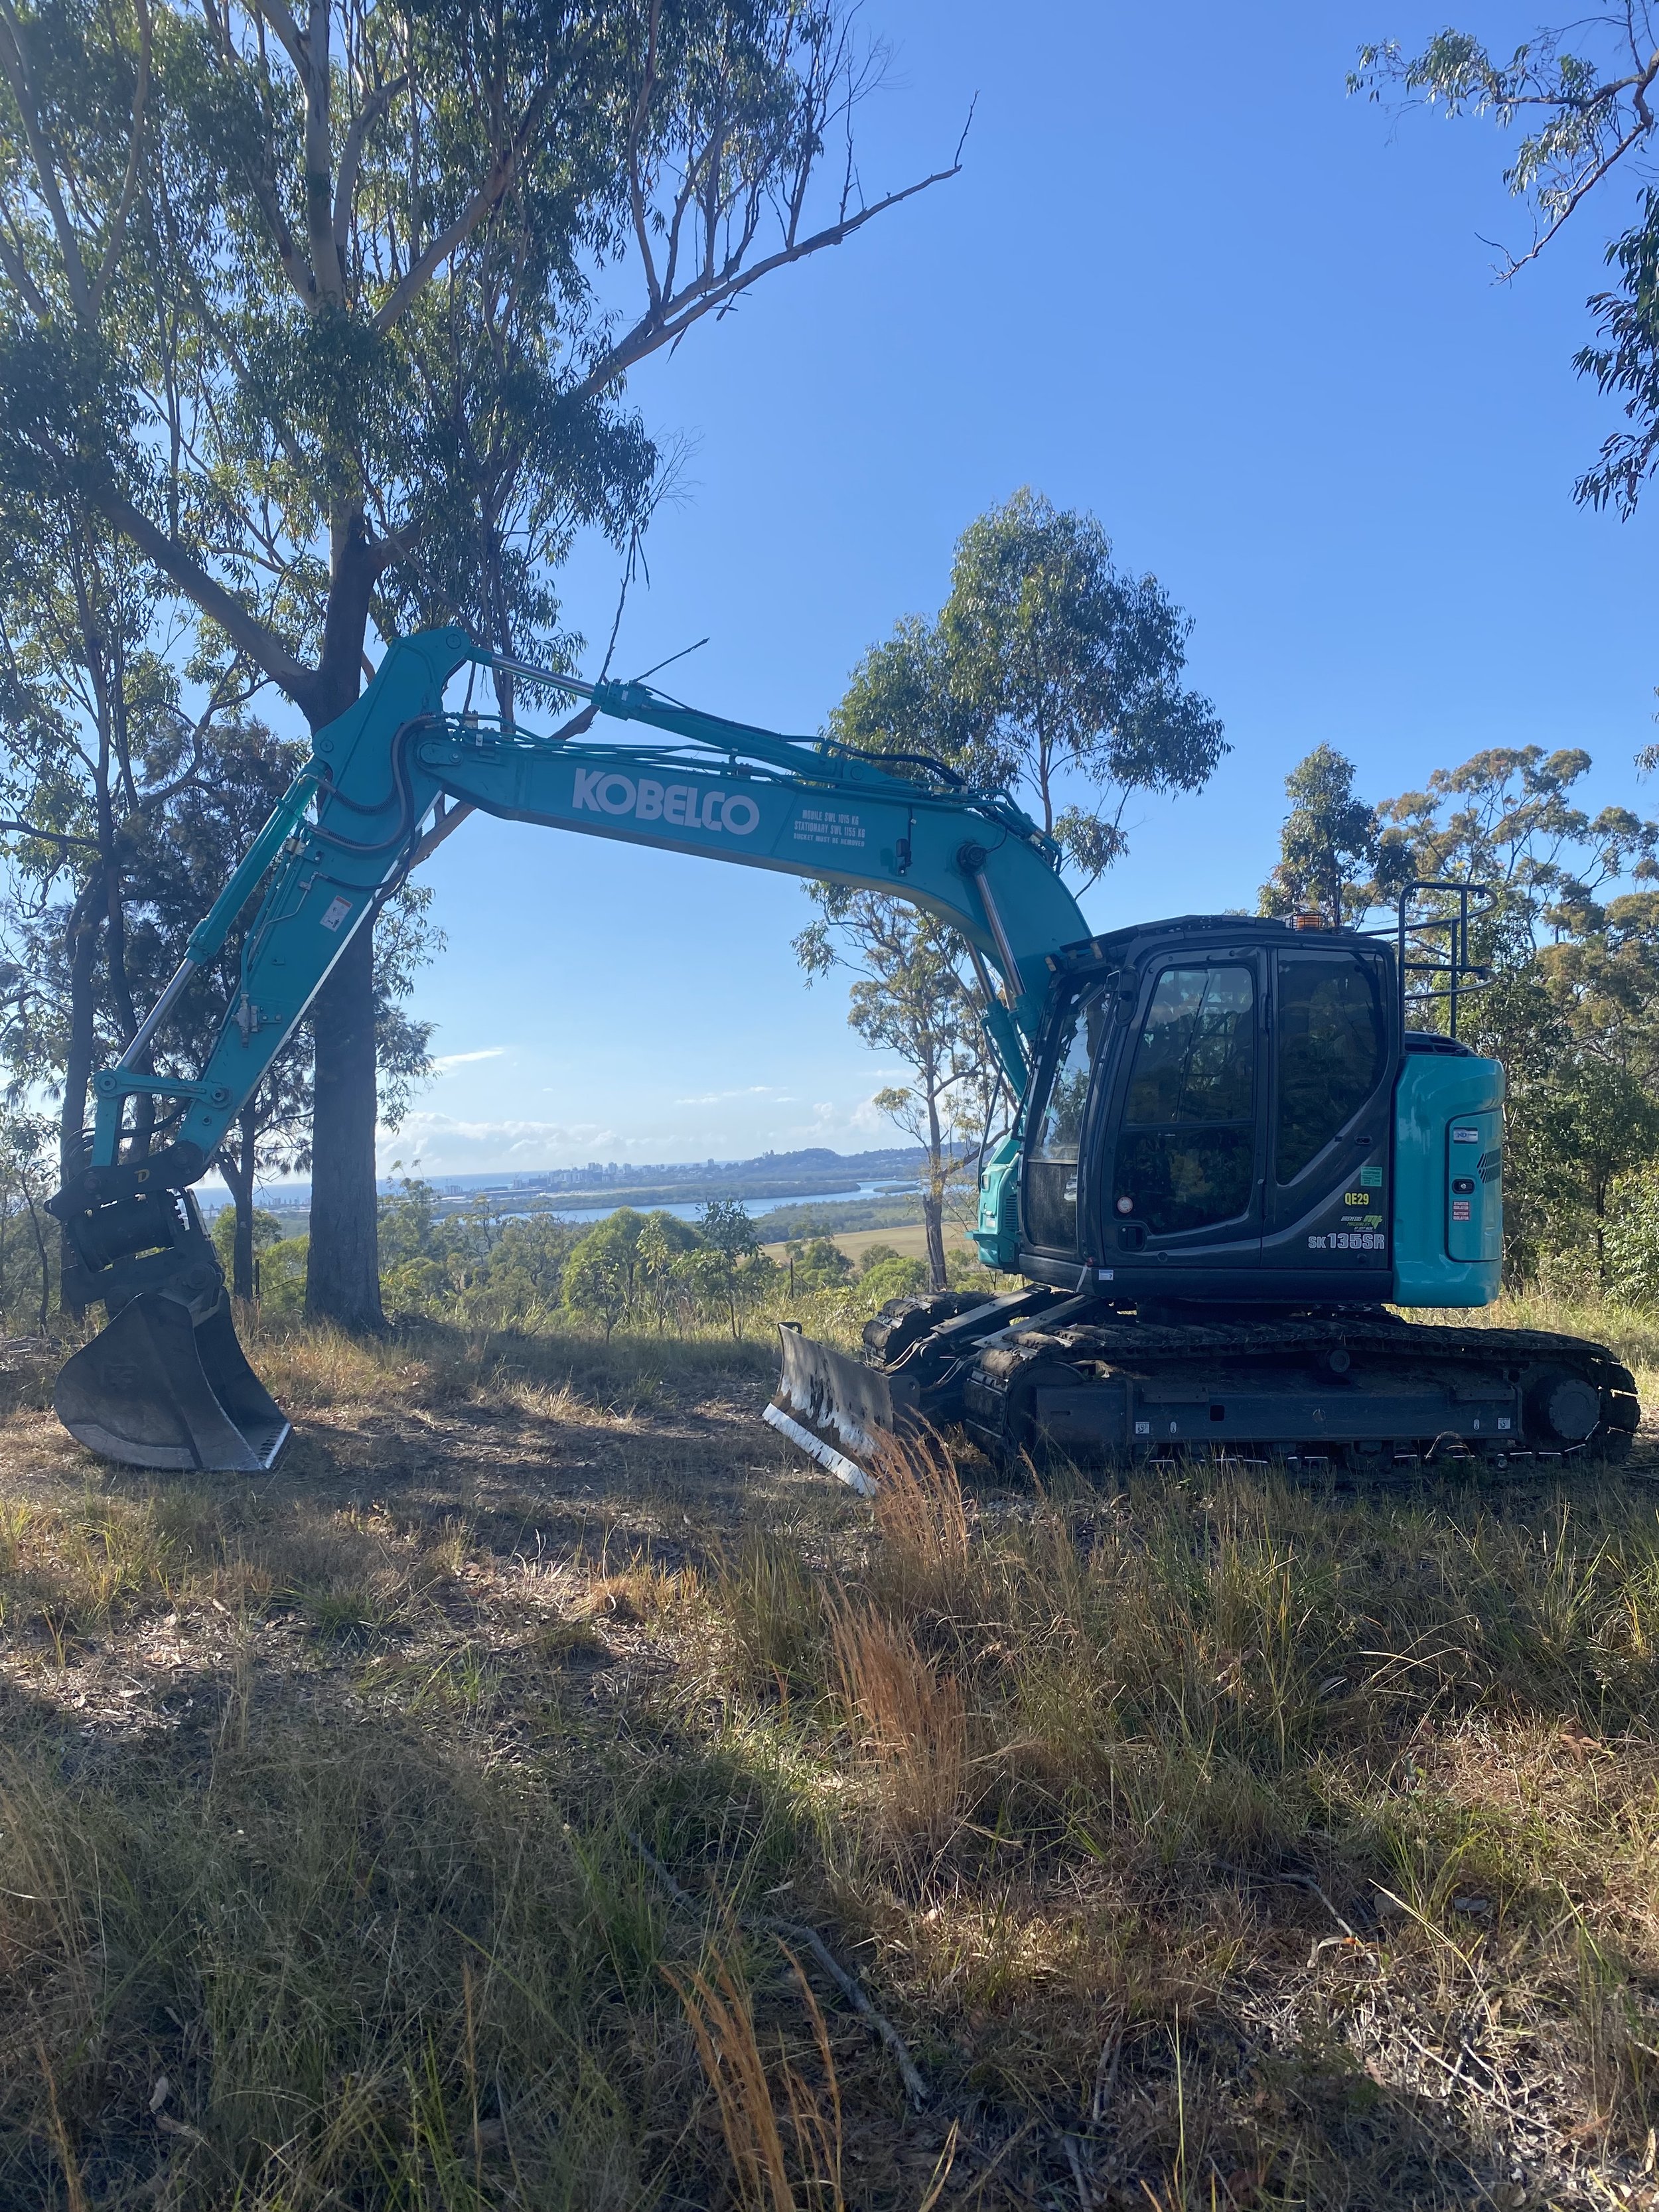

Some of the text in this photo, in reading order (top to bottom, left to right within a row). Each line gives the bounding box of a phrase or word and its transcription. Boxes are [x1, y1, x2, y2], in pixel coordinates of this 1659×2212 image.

[572, 768, 760, 835] KOBELCO
[802, 810, 859, 826] MOBILE SWL 1015 KG
[794, 820, 865, 838] STATIONARY SWL 1155 KG
[815, 835, 830, 844] MUST
[840, 838, 865, 847] REMOVED
[1344, 1193, 1370, 1206] QE29
